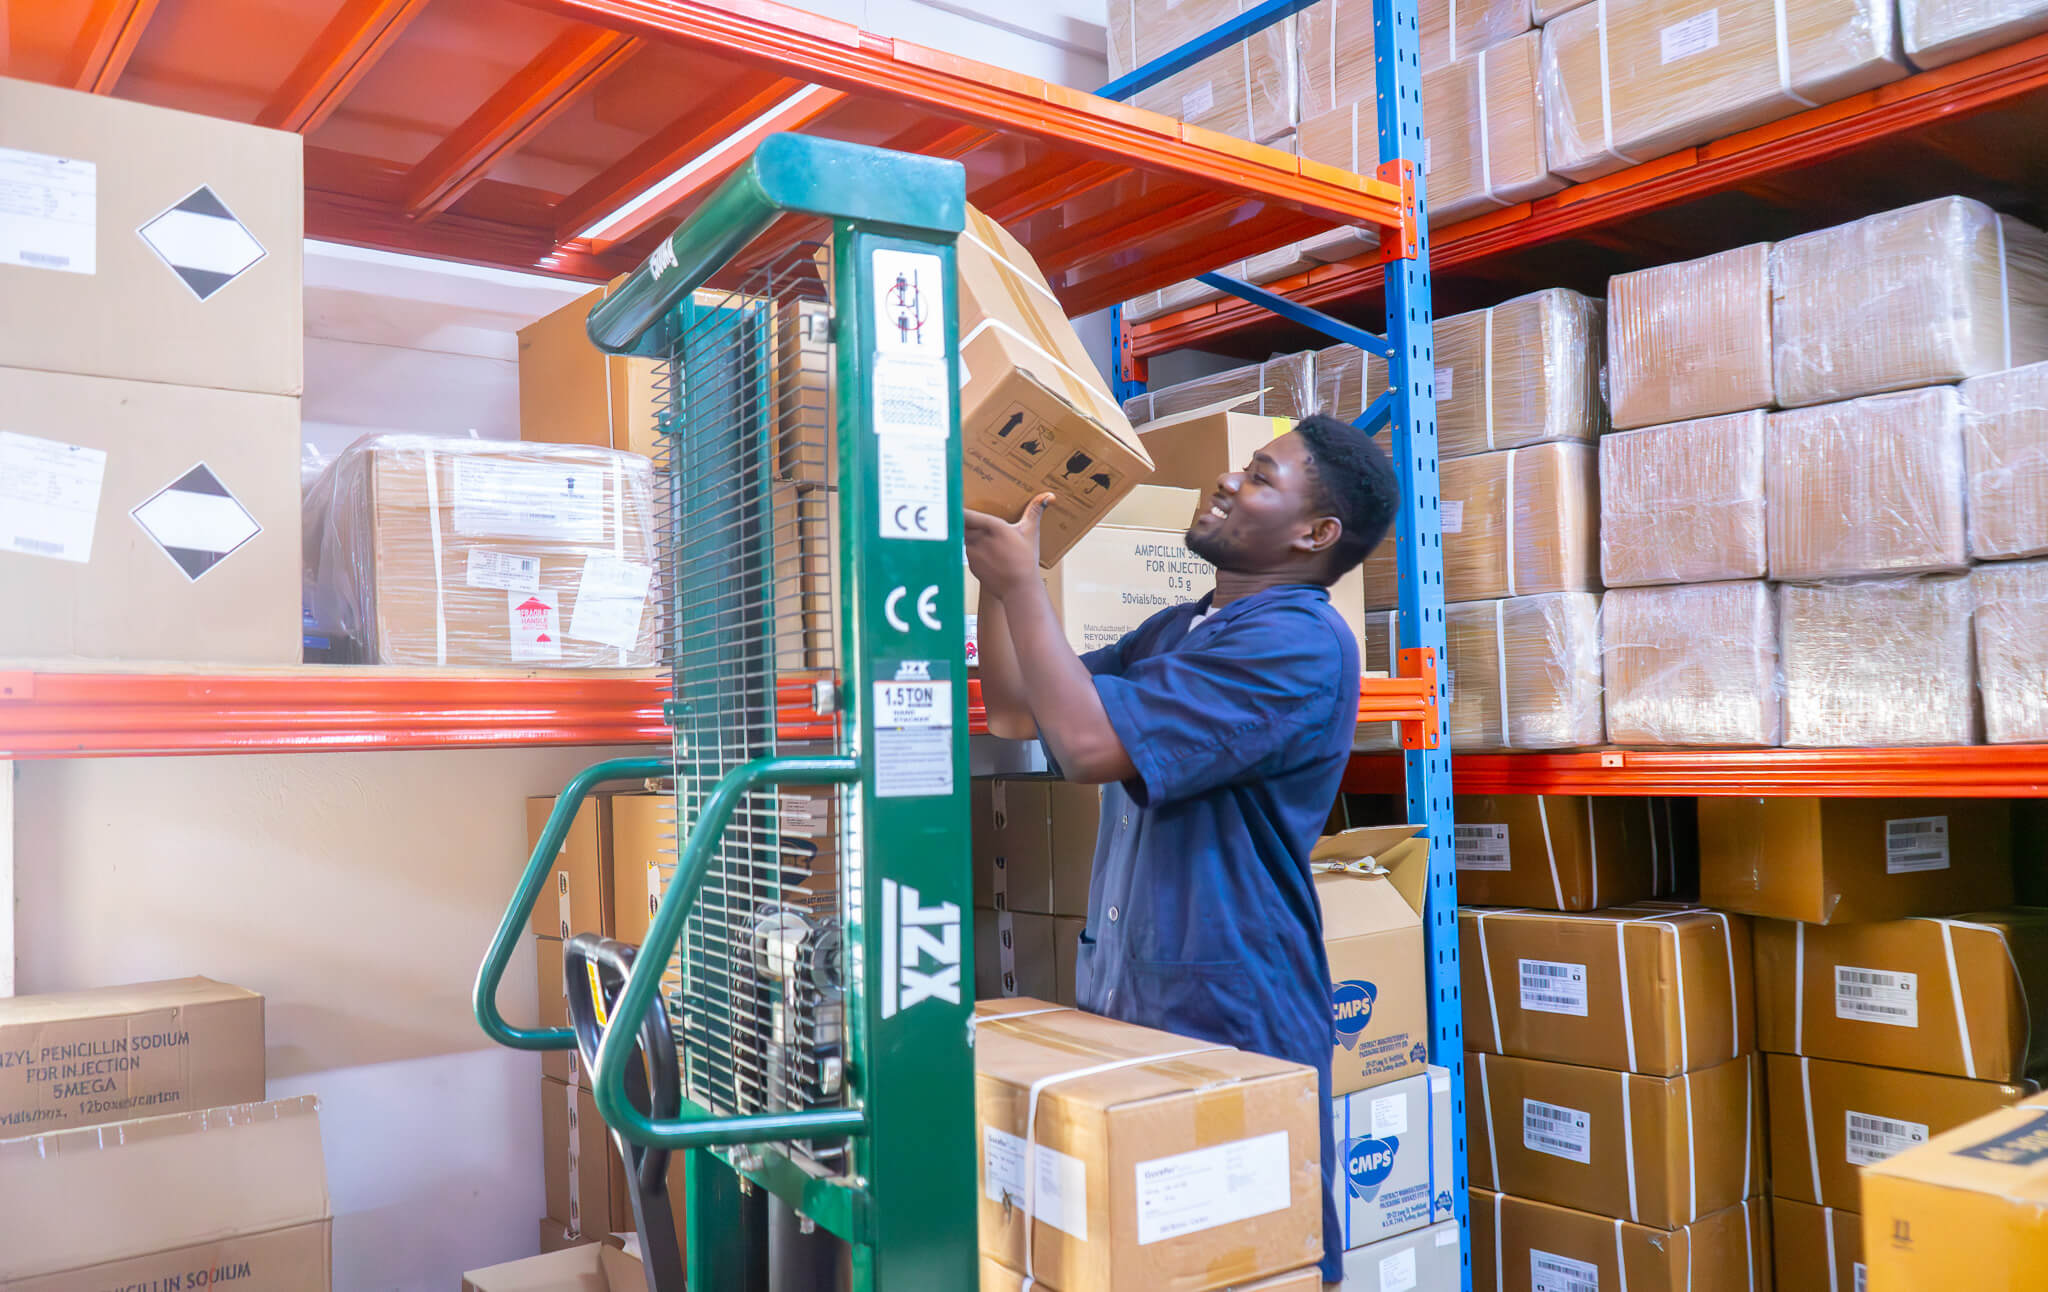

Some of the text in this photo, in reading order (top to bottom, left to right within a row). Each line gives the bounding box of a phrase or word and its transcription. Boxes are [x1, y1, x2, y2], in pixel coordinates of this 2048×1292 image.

[894, 504, 928, 532] CE
[1135, 544, 1185, 558] AMPICILLIN
[1146, 560, 1215, 575] FOR INJECTION
[1169, 576, 1192, 591] 0.5 g
[885, 584, 942, 632] CE
[1084, 633, 1119, 641] REYOUNG
[885, 687, 933, 706] 1.5 TON
[41, 1037, 127, 1063] PENICILLIN
[132, 1031, 190, 1051] SODIUM
[27, 1056, 140, 1083] FOR INJECTION
[53, 1077, 117, 1099] 5MEGA
[1350, 1149, 1391, 1175] CMPS
[187, 1261, 251, 1289] SODIUM
